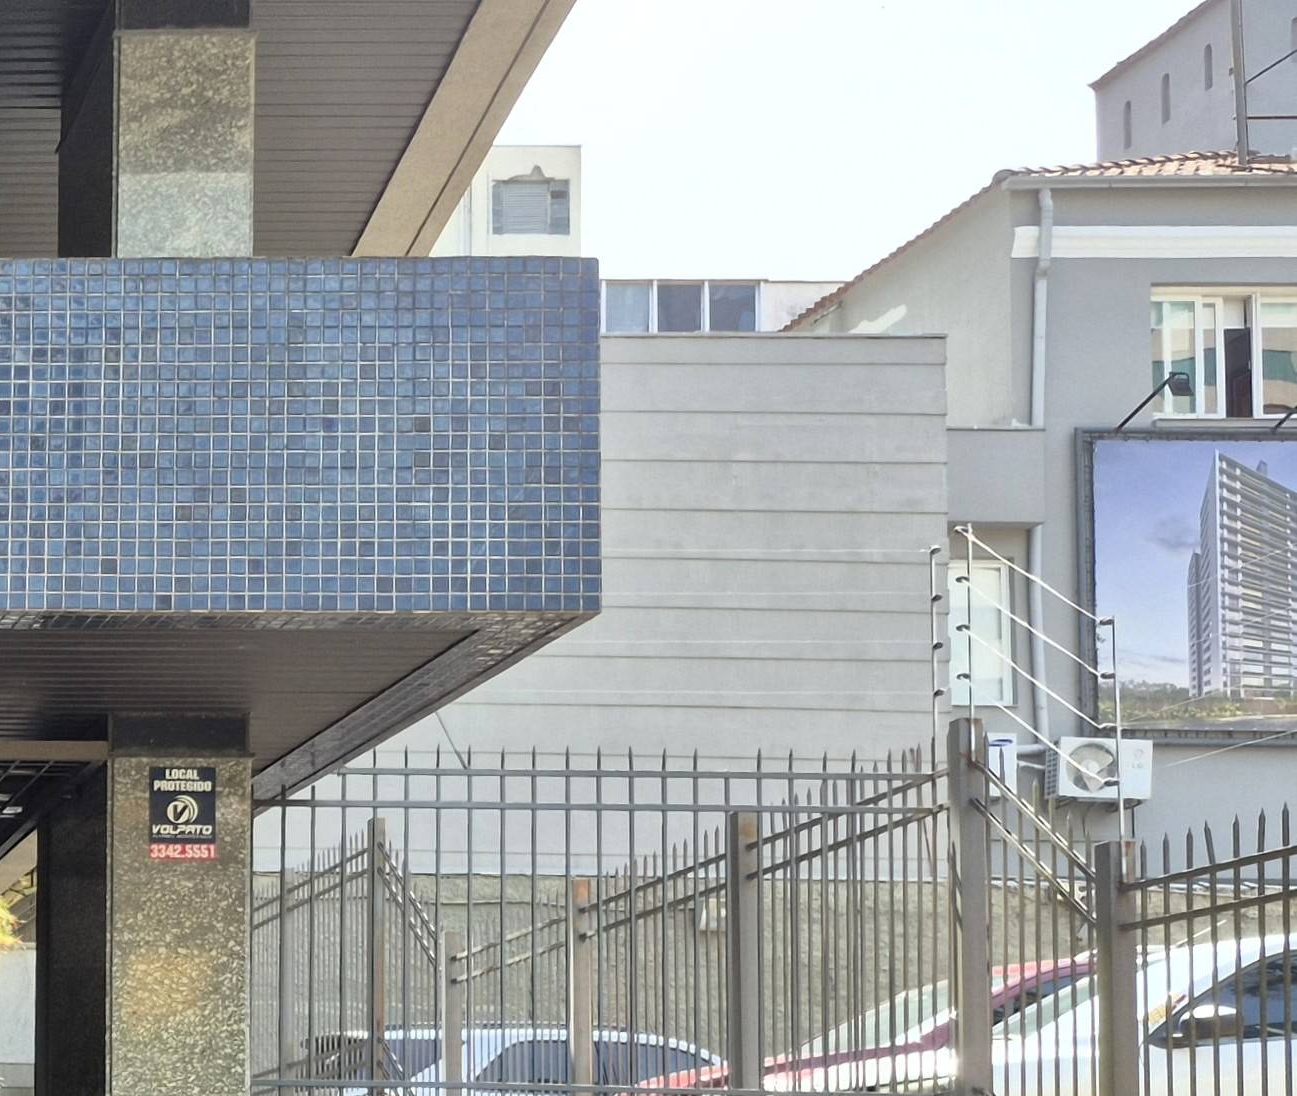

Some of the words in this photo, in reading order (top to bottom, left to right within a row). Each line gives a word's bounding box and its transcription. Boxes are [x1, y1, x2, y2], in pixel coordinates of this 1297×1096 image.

[165, 768, 200, 780] LOCAL
[153, 780, 212, 792] PROTEGIDO
[152, 824, 212, 835] VOLPATO
[150, 844, 215, 858] 3342.5551
